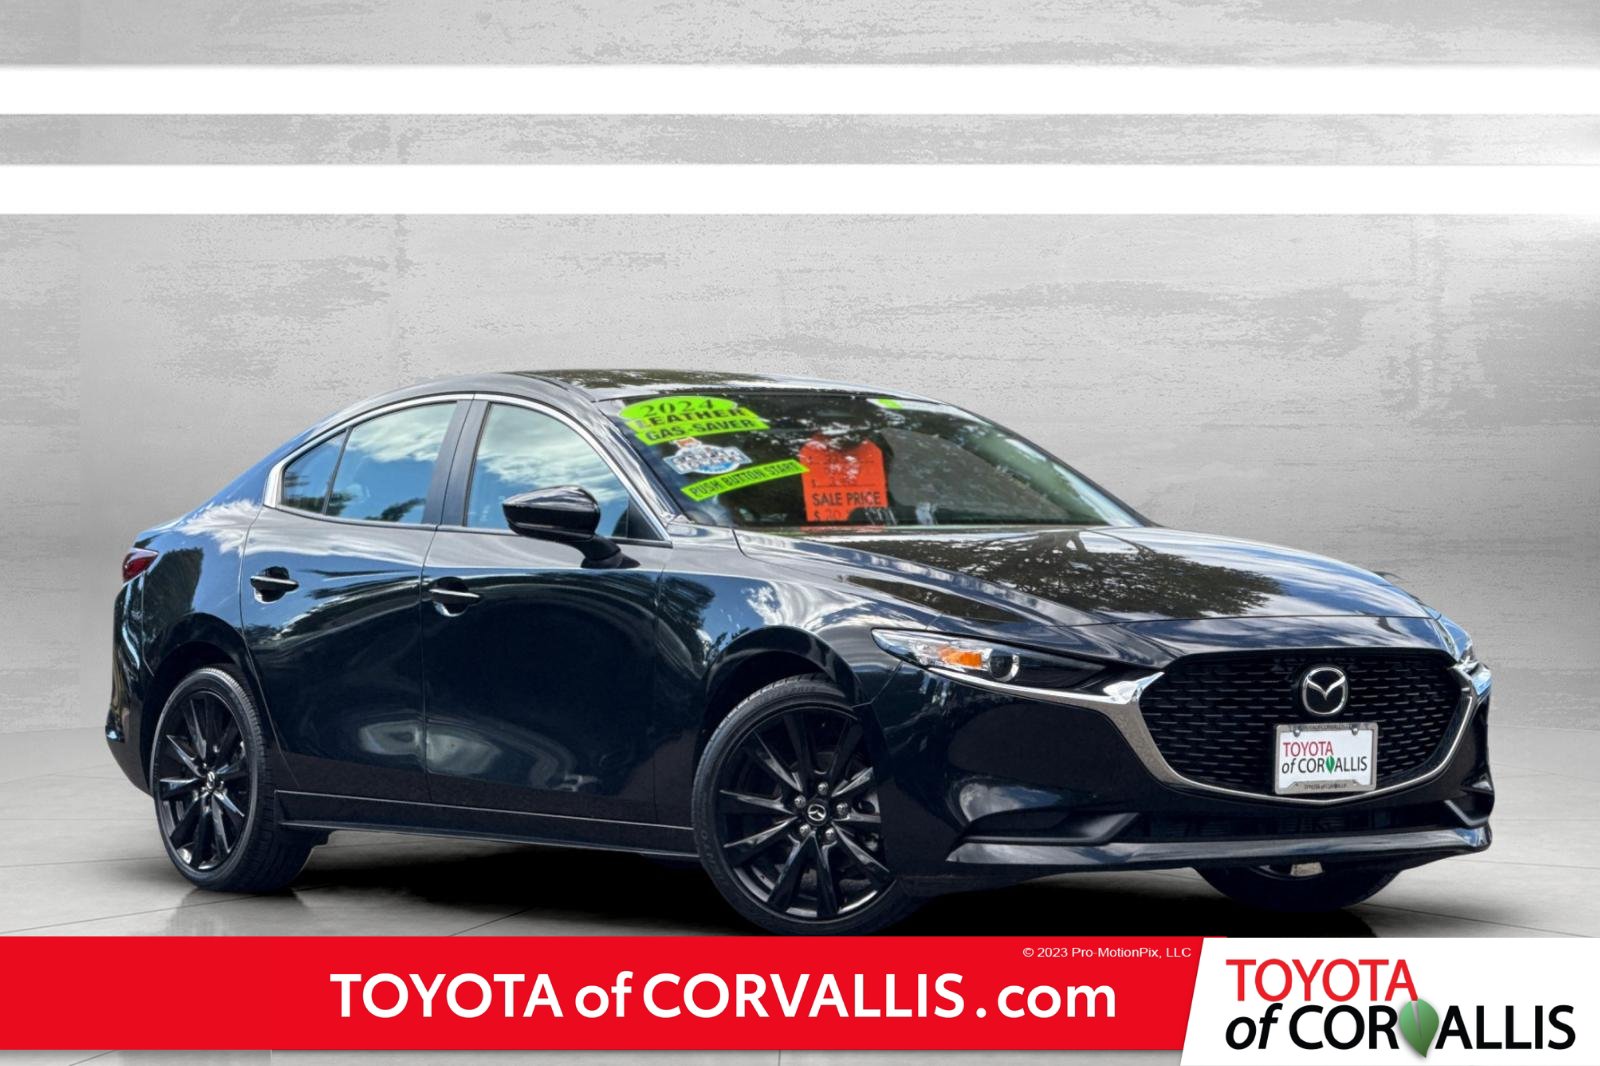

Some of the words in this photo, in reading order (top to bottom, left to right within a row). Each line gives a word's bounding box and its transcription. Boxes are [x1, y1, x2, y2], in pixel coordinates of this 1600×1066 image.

[640, 399, 714, 417] 2024
[635, 409, 747, 430] LEATHER
[689, 480, 721, 498] PUSH
[721, 470, 766, 487] BUTTON
[764, 461, 800, 477] START
[812, 492, 842, 506] SALE
[847, 491, 881, 506] PRICE
[1282, 741, 1334, 758] TOYOTA
[1281, 758, 1296, 774] of
